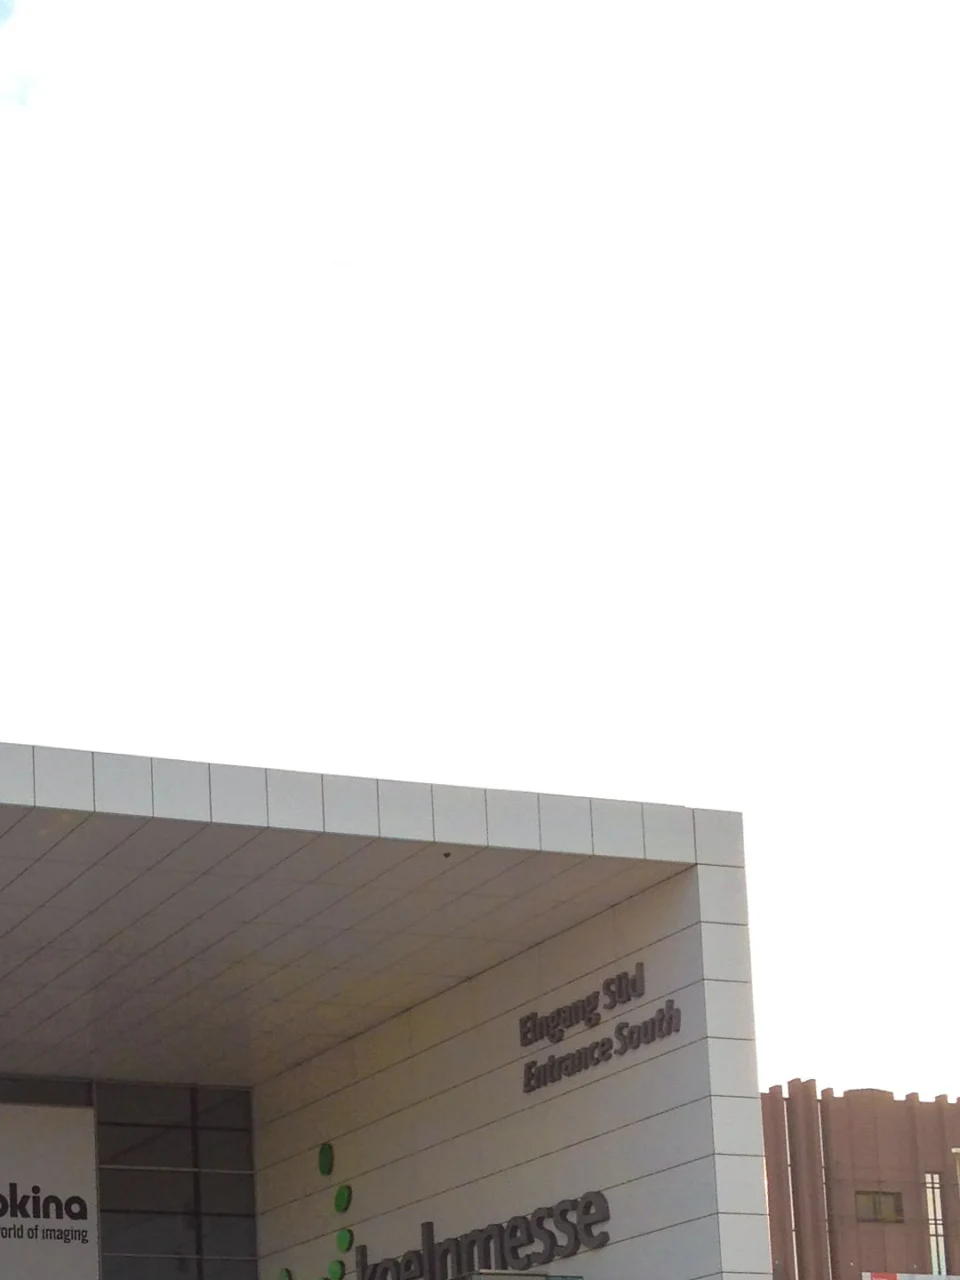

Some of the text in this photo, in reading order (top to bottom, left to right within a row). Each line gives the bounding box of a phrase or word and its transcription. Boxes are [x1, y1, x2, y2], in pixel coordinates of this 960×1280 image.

[519, 991, 601, 1046] Eingang
[523, 999, 682, 1093] Entrance South
[26, 1225, 39, 1239] of
[41, 1228, 89, 1244] imaging
